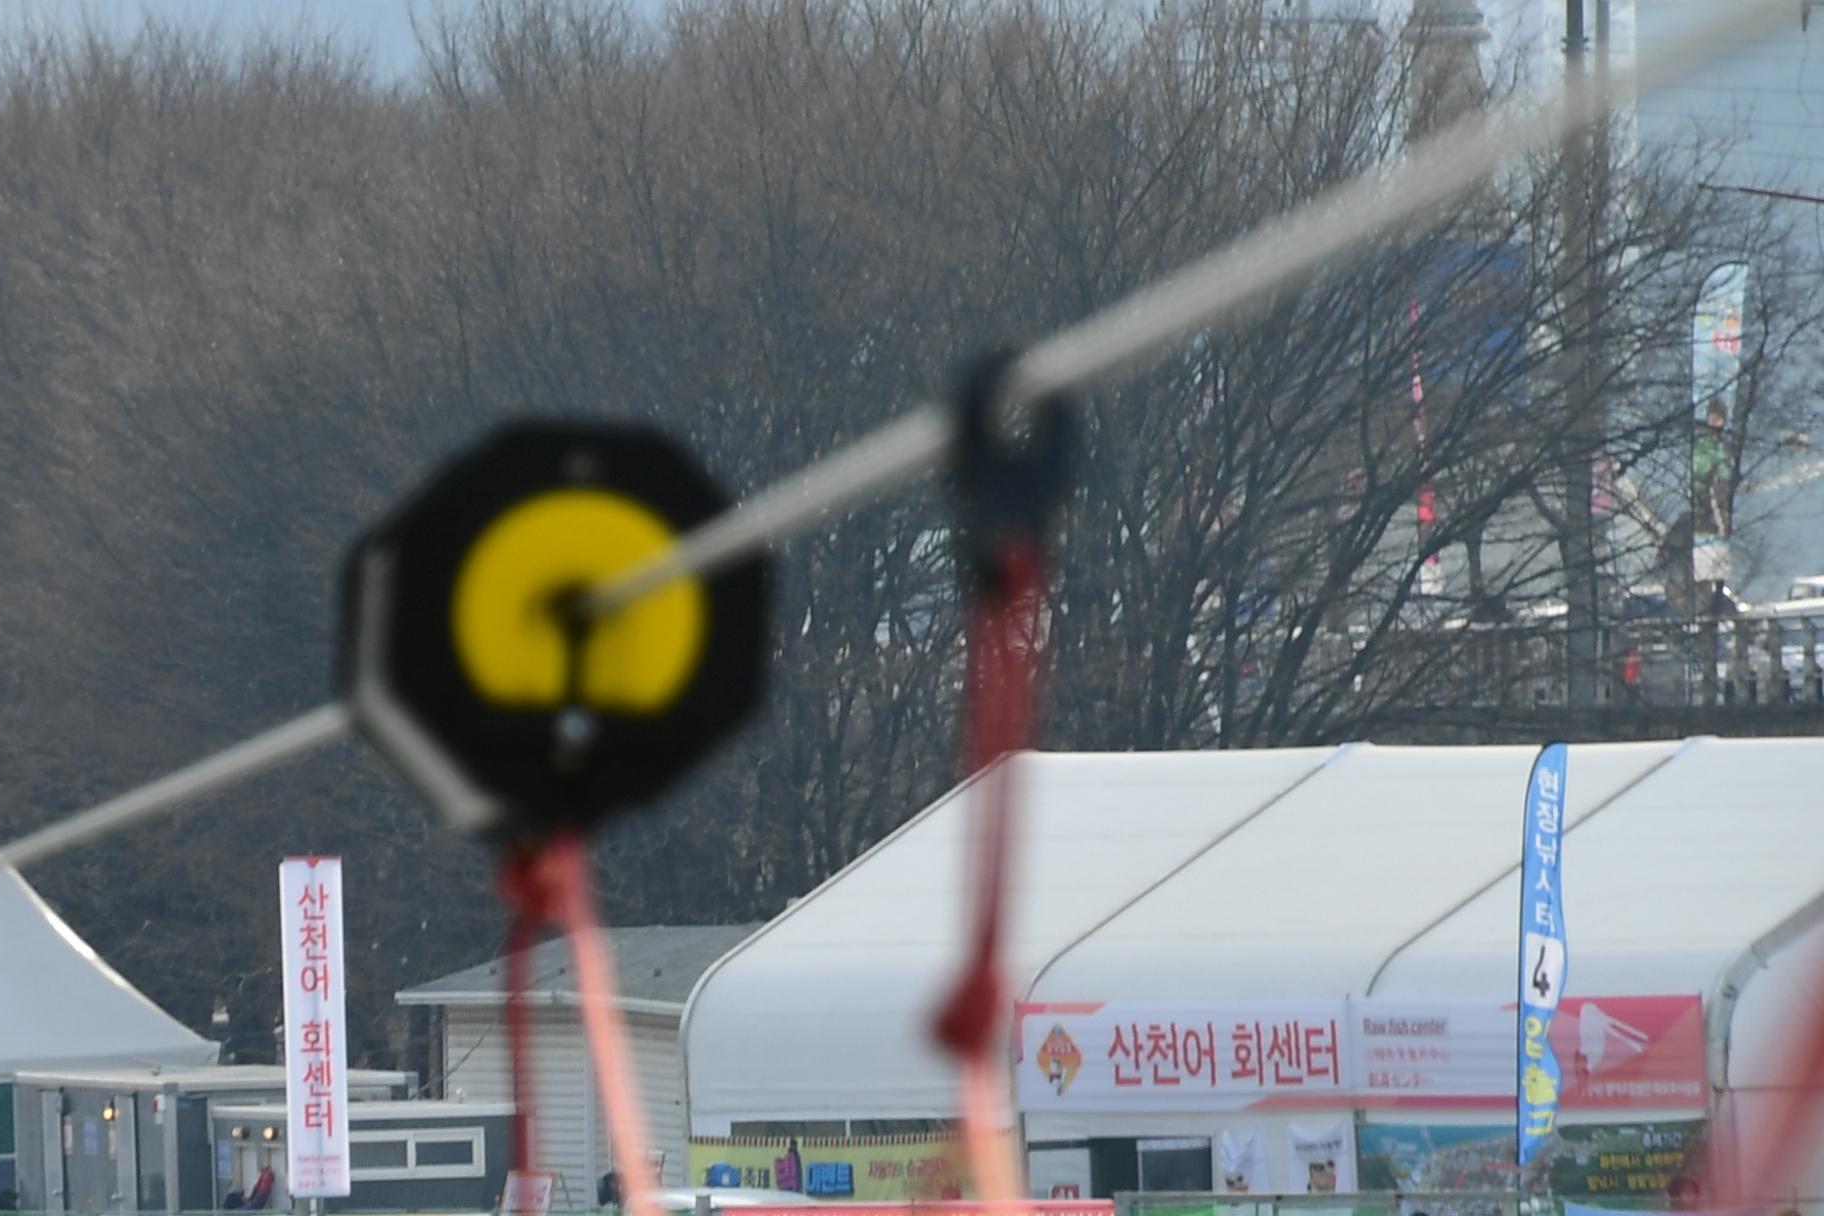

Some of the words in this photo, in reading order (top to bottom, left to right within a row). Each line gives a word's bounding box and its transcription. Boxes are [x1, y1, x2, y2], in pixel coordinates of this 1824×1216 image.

[298, 883, 330, 1003] 산천어
[1532, 946, 1551, 998] 4
[1108, 1023, 1216, 1087] 산천어
[1231, 1020, 1339, 1087] 회센터
[1363, 1017, 1386, 1035] Raw
[1388, 1017, 1409, 1035] fish
[1411, 1018, 1447, 1035] center
[300, 1019, 335, 1138] 회센터
[806, 1161, 855, 1197] 이벤트
